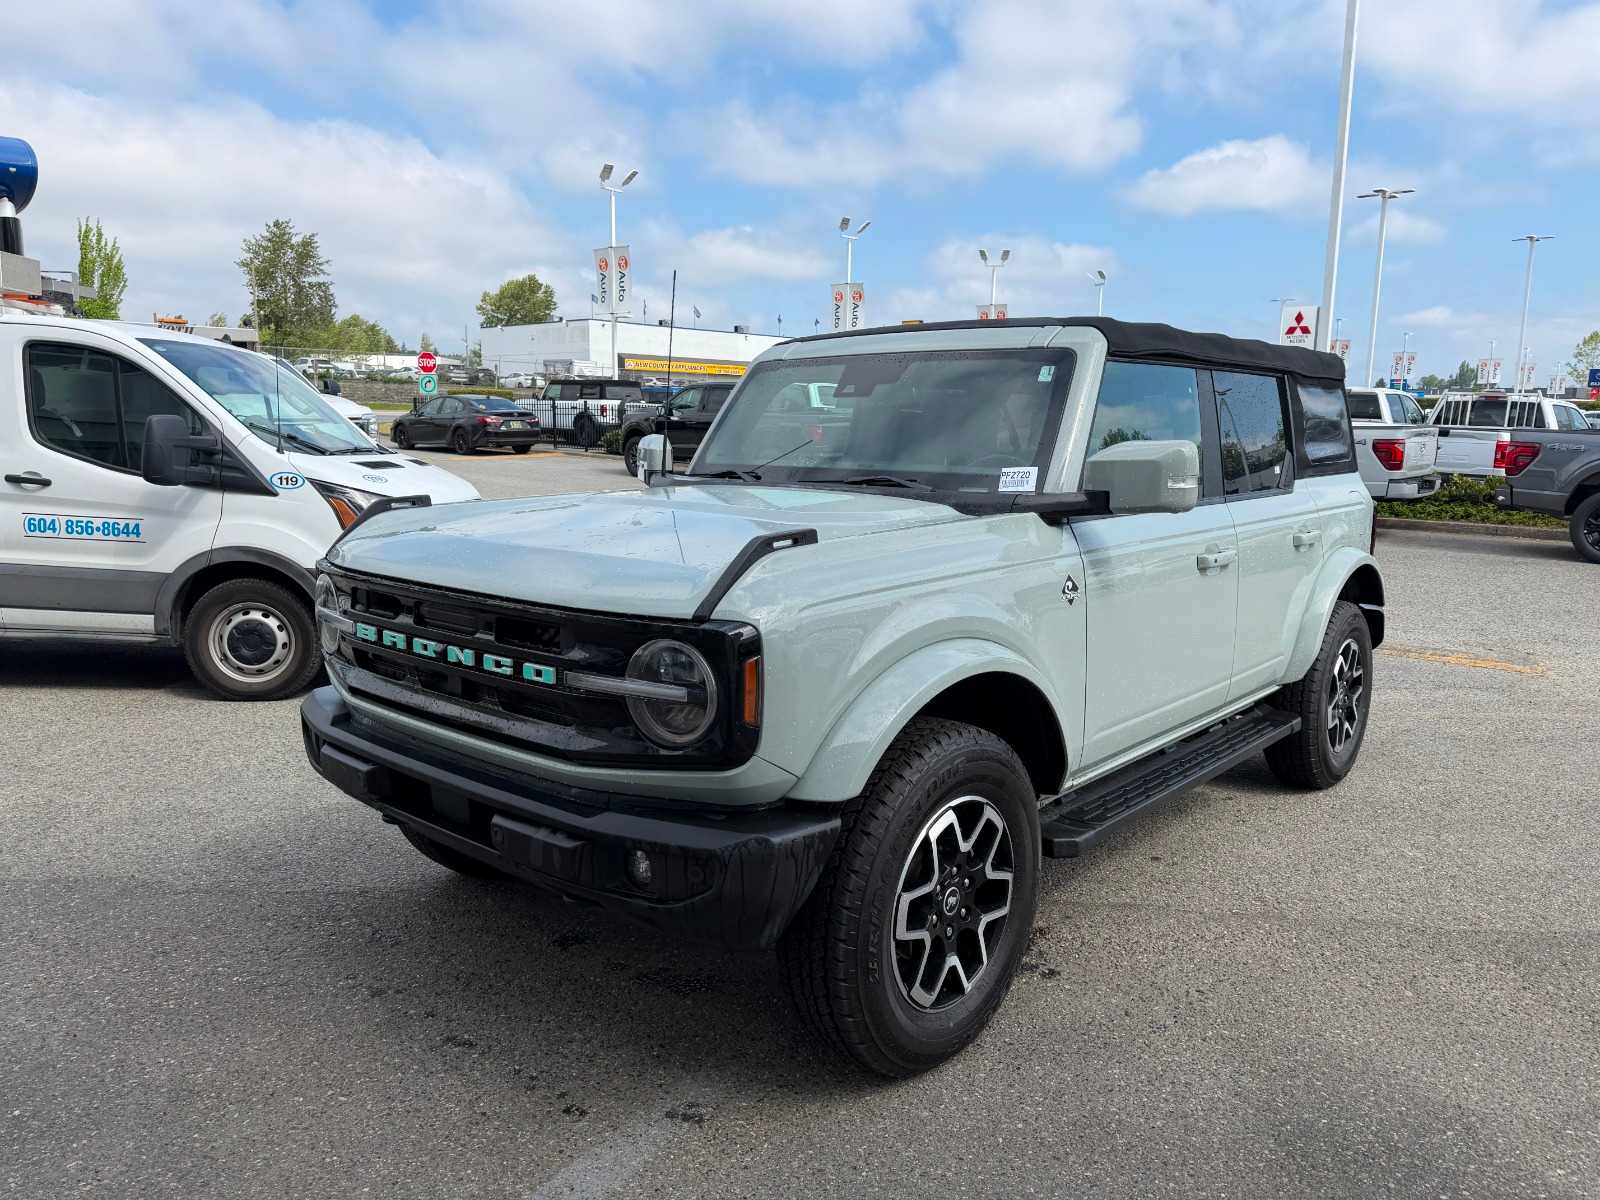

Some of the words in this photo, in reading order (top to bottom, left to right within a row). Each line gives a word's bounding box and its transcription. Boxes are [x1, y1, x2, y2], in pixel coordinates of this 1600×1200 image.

[618, 270, 626, 303] Auto
[833, 303, 841, 329] Auto
[851, 302, 860, 328] Auto
[419, 358, 436, 367] STOP
[278, 475, 299, 487] 119
[23, 515, 61, 536] (604)
[355, 621, 557, 685] BRONCO
